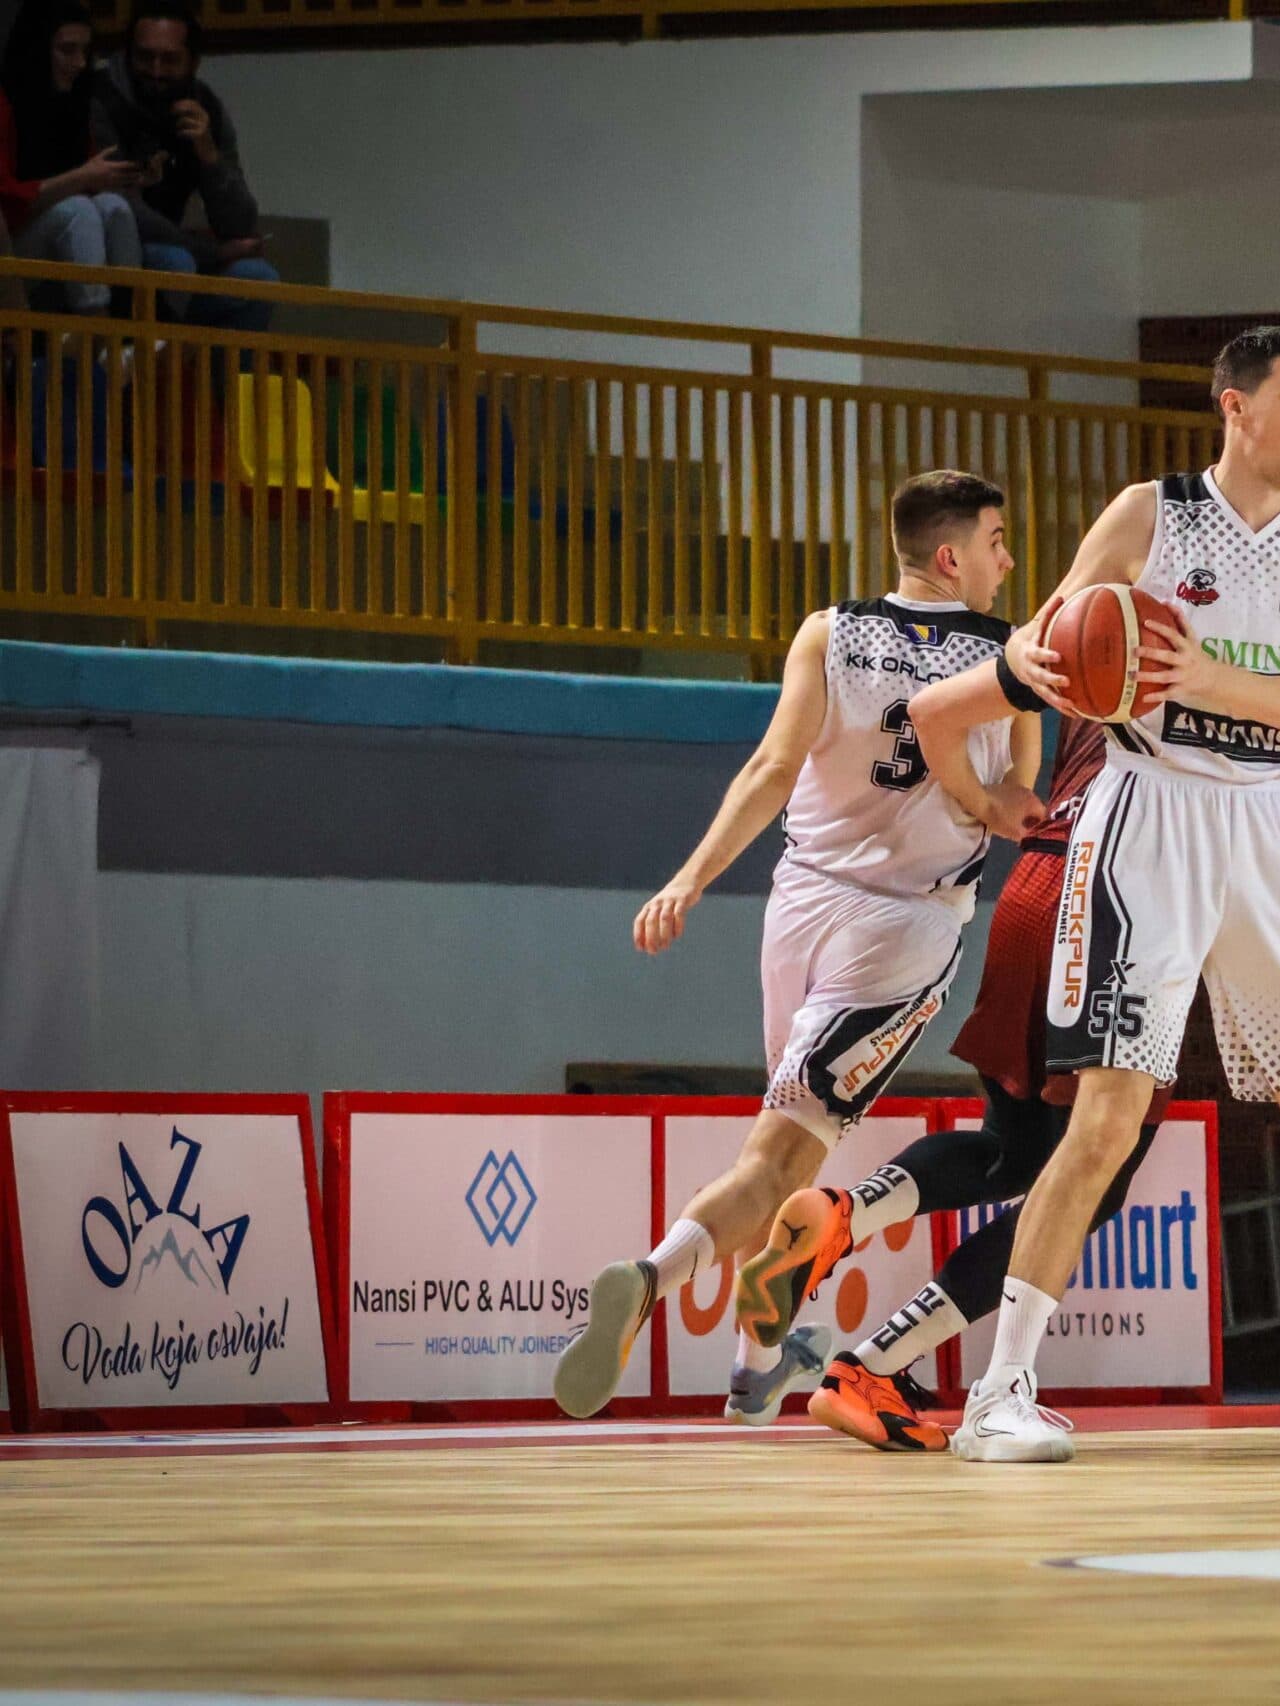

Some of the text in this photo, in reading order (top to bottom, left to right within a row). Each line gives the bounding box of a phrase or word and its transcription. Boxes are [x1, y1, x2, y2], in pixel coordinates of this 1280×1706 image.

[846, 652, 953, 685] KK ORLO
[1058, 903, 1068, 944] PANELS
[1063, 841, 1095, 1009] ROCKPUR
[1088, 989, 1148, 1040] 55
[81, 1125, 250, 1296] OAZA
[353, 1278, 597, 1320] Nansi PVC & ALU Sys
[62, 1297, 289, 1390] Voda koja osvaja!
[425, 1336, 458, 1355] HIGH
[461, 1335, 515, 1355] QUALITY
[1047, 1312, 1145, 1337] LUTIONS
